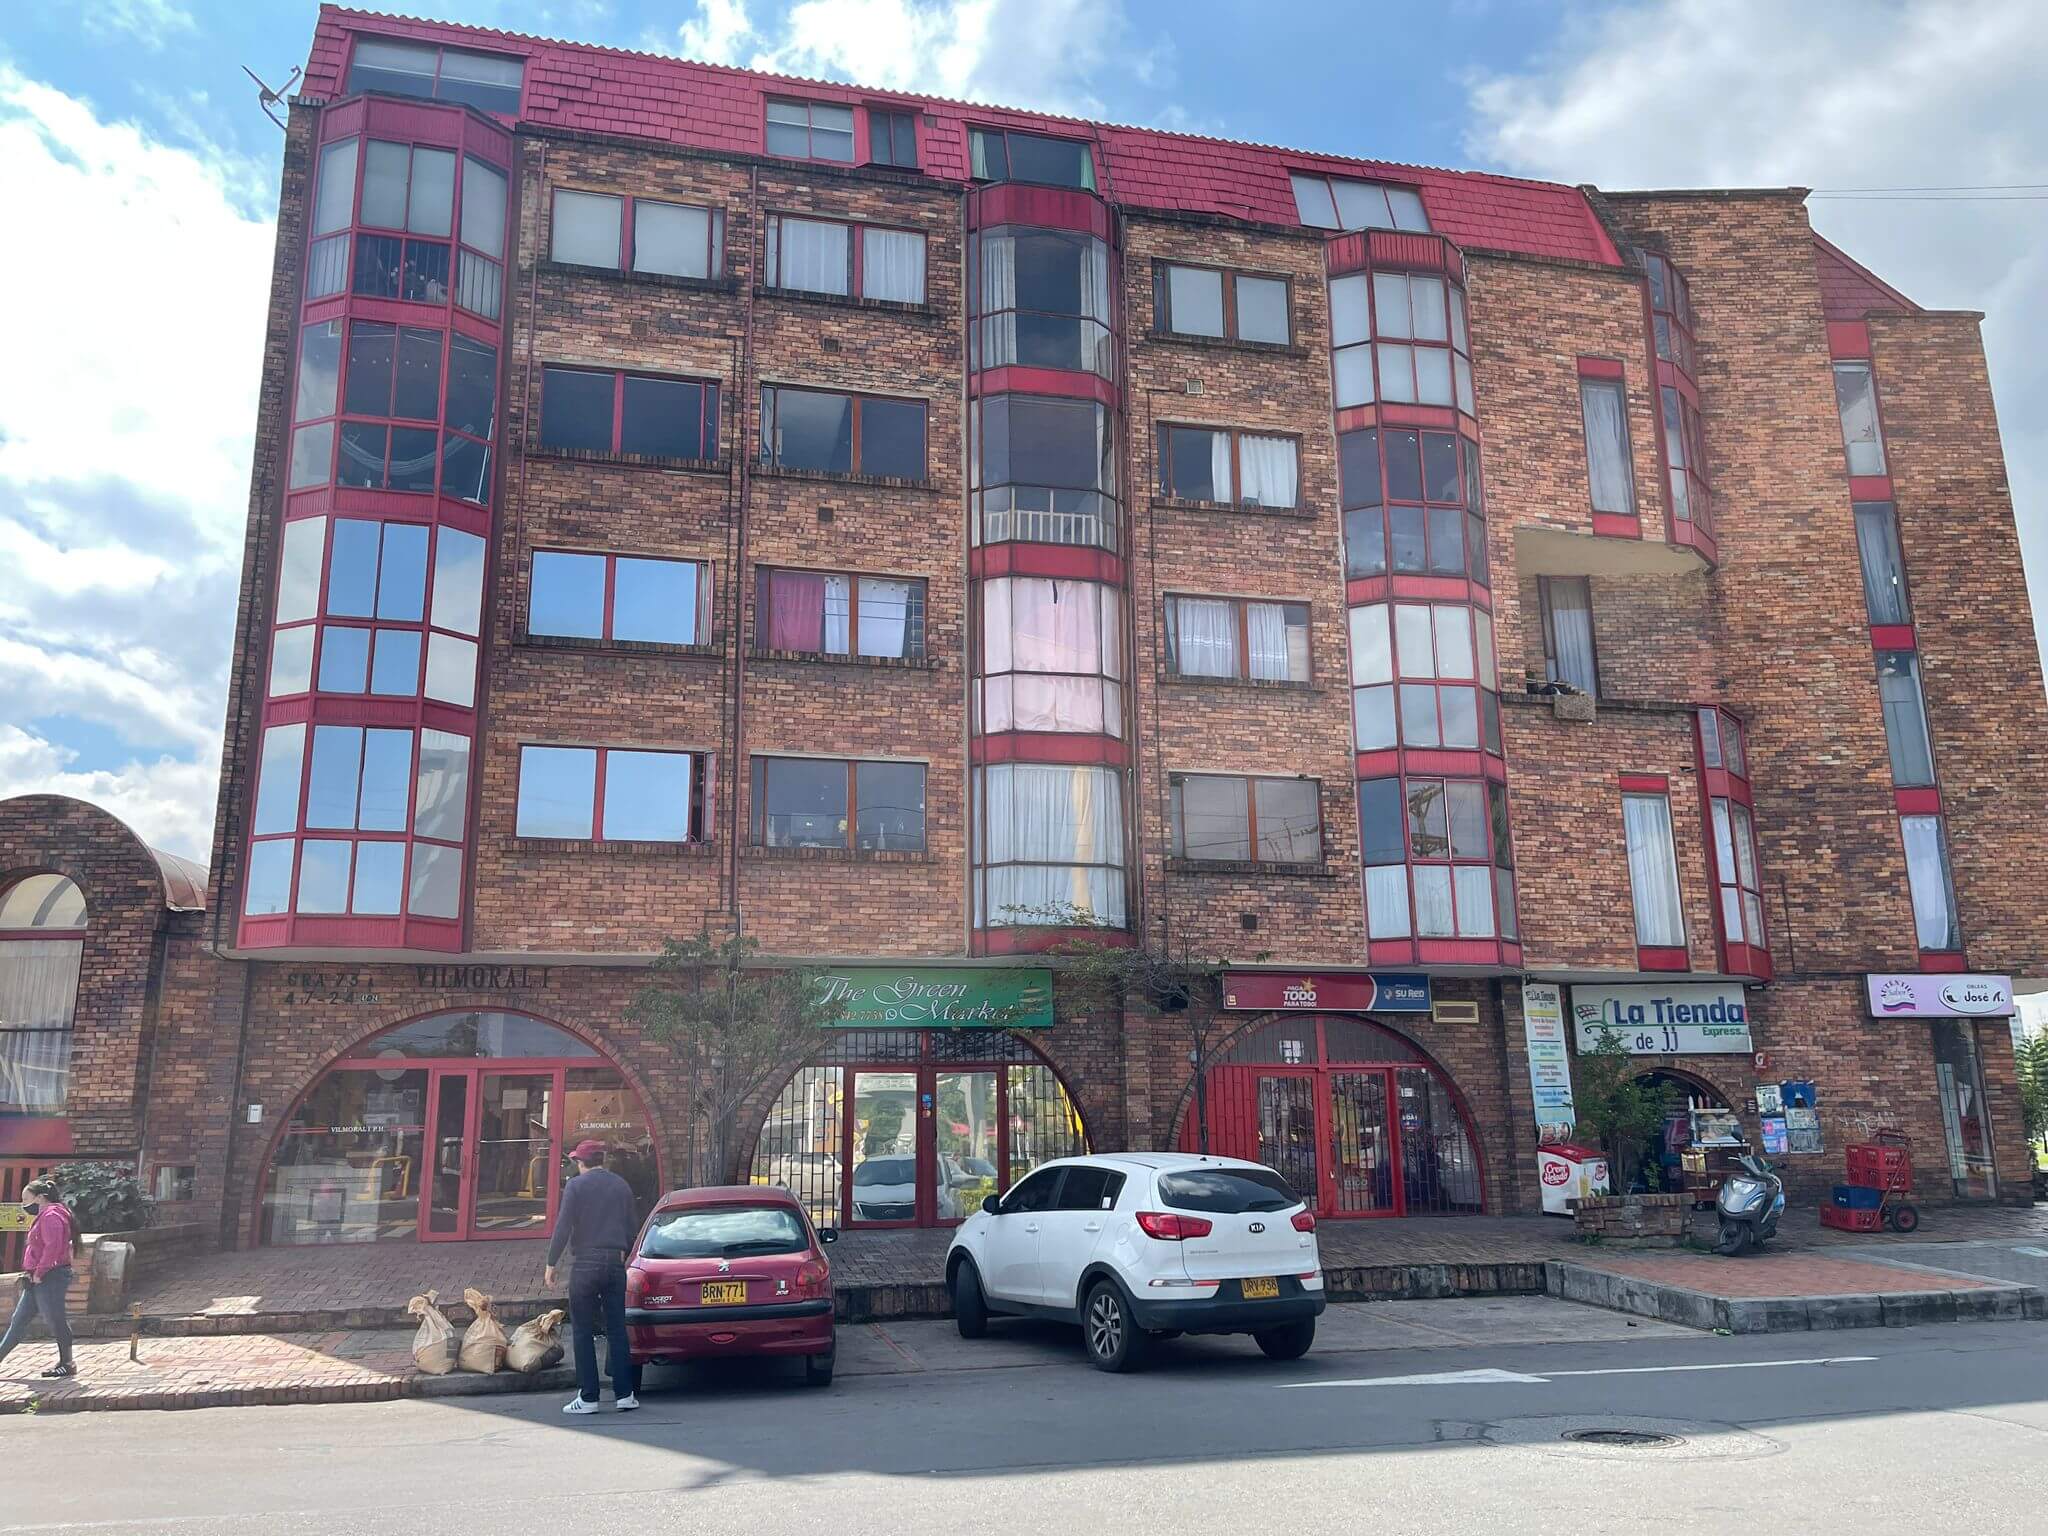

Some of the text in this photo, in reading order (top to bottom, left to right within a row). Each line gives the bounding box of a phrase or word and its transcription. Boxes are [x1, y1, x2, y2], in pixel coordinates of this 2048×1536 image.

[416, 966, 529, 988] VILMORAL
[811, 976, 866, 1005] The
[873, 976, 968, 1005] Green
[1283, 990, 1317, 1001] TODO
[1395, 989, 1407, 998] SU
[1964, 991, 1989, 1002] José
[1613, 996, 1745, 1024] La Tienda
[1636, 1032, 1653, 1050] de
